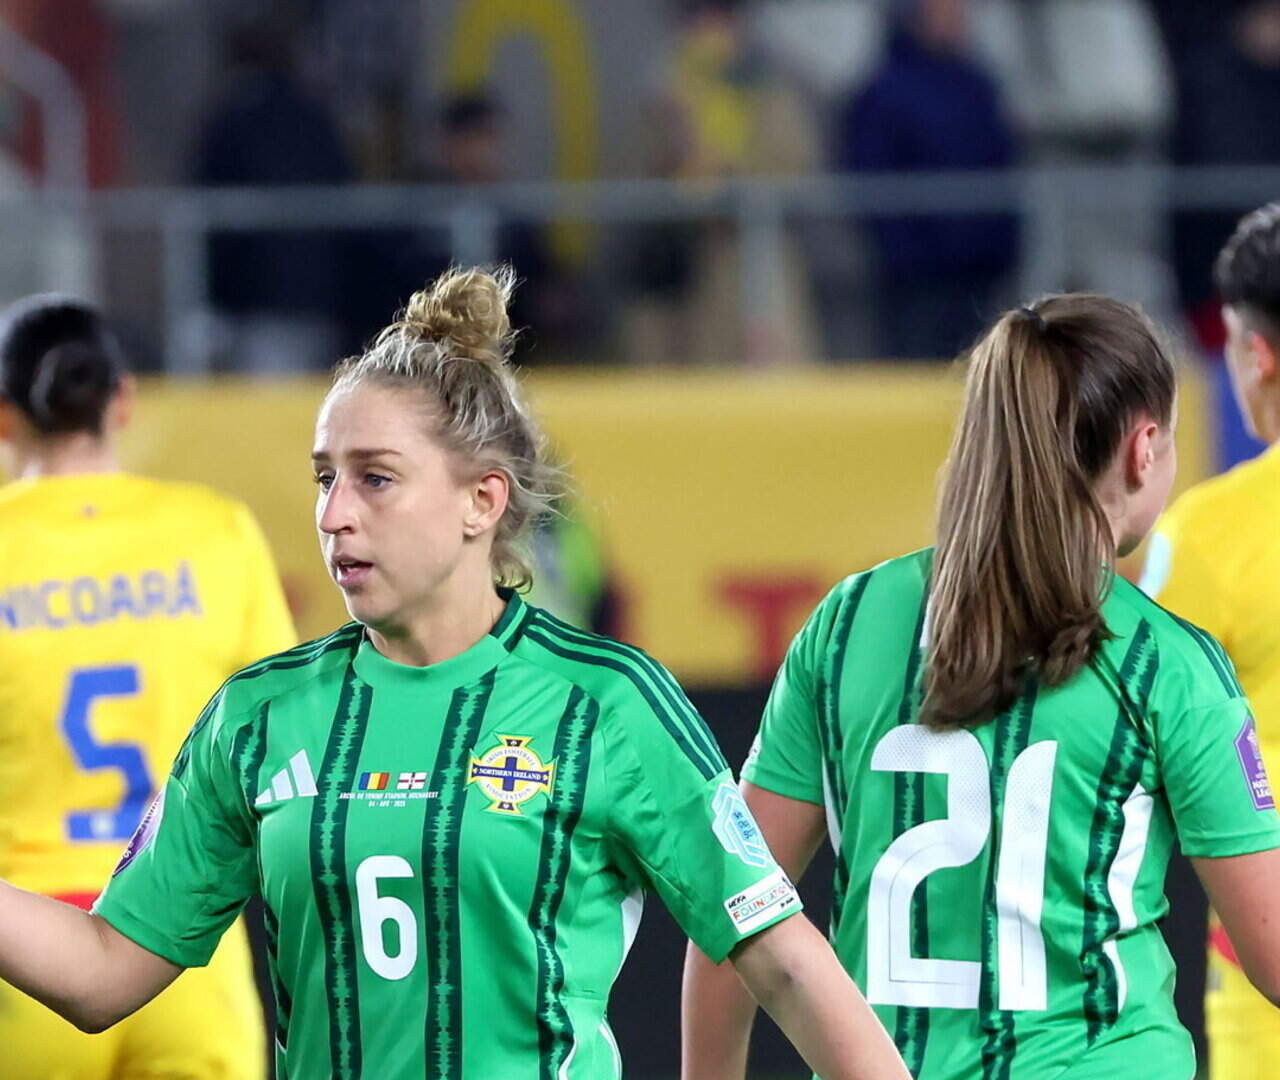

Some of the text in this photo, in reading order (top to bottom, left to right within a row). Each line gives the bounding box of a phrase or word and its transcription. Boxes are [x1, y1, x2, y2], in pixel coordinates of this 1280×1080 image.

[60, 663, 154, 841] 5
[479, 768, 541, 780] NORTHERN IRELAND
[355, 855, 418, 980] 6
[867, 724, 1059, 1011] 21
